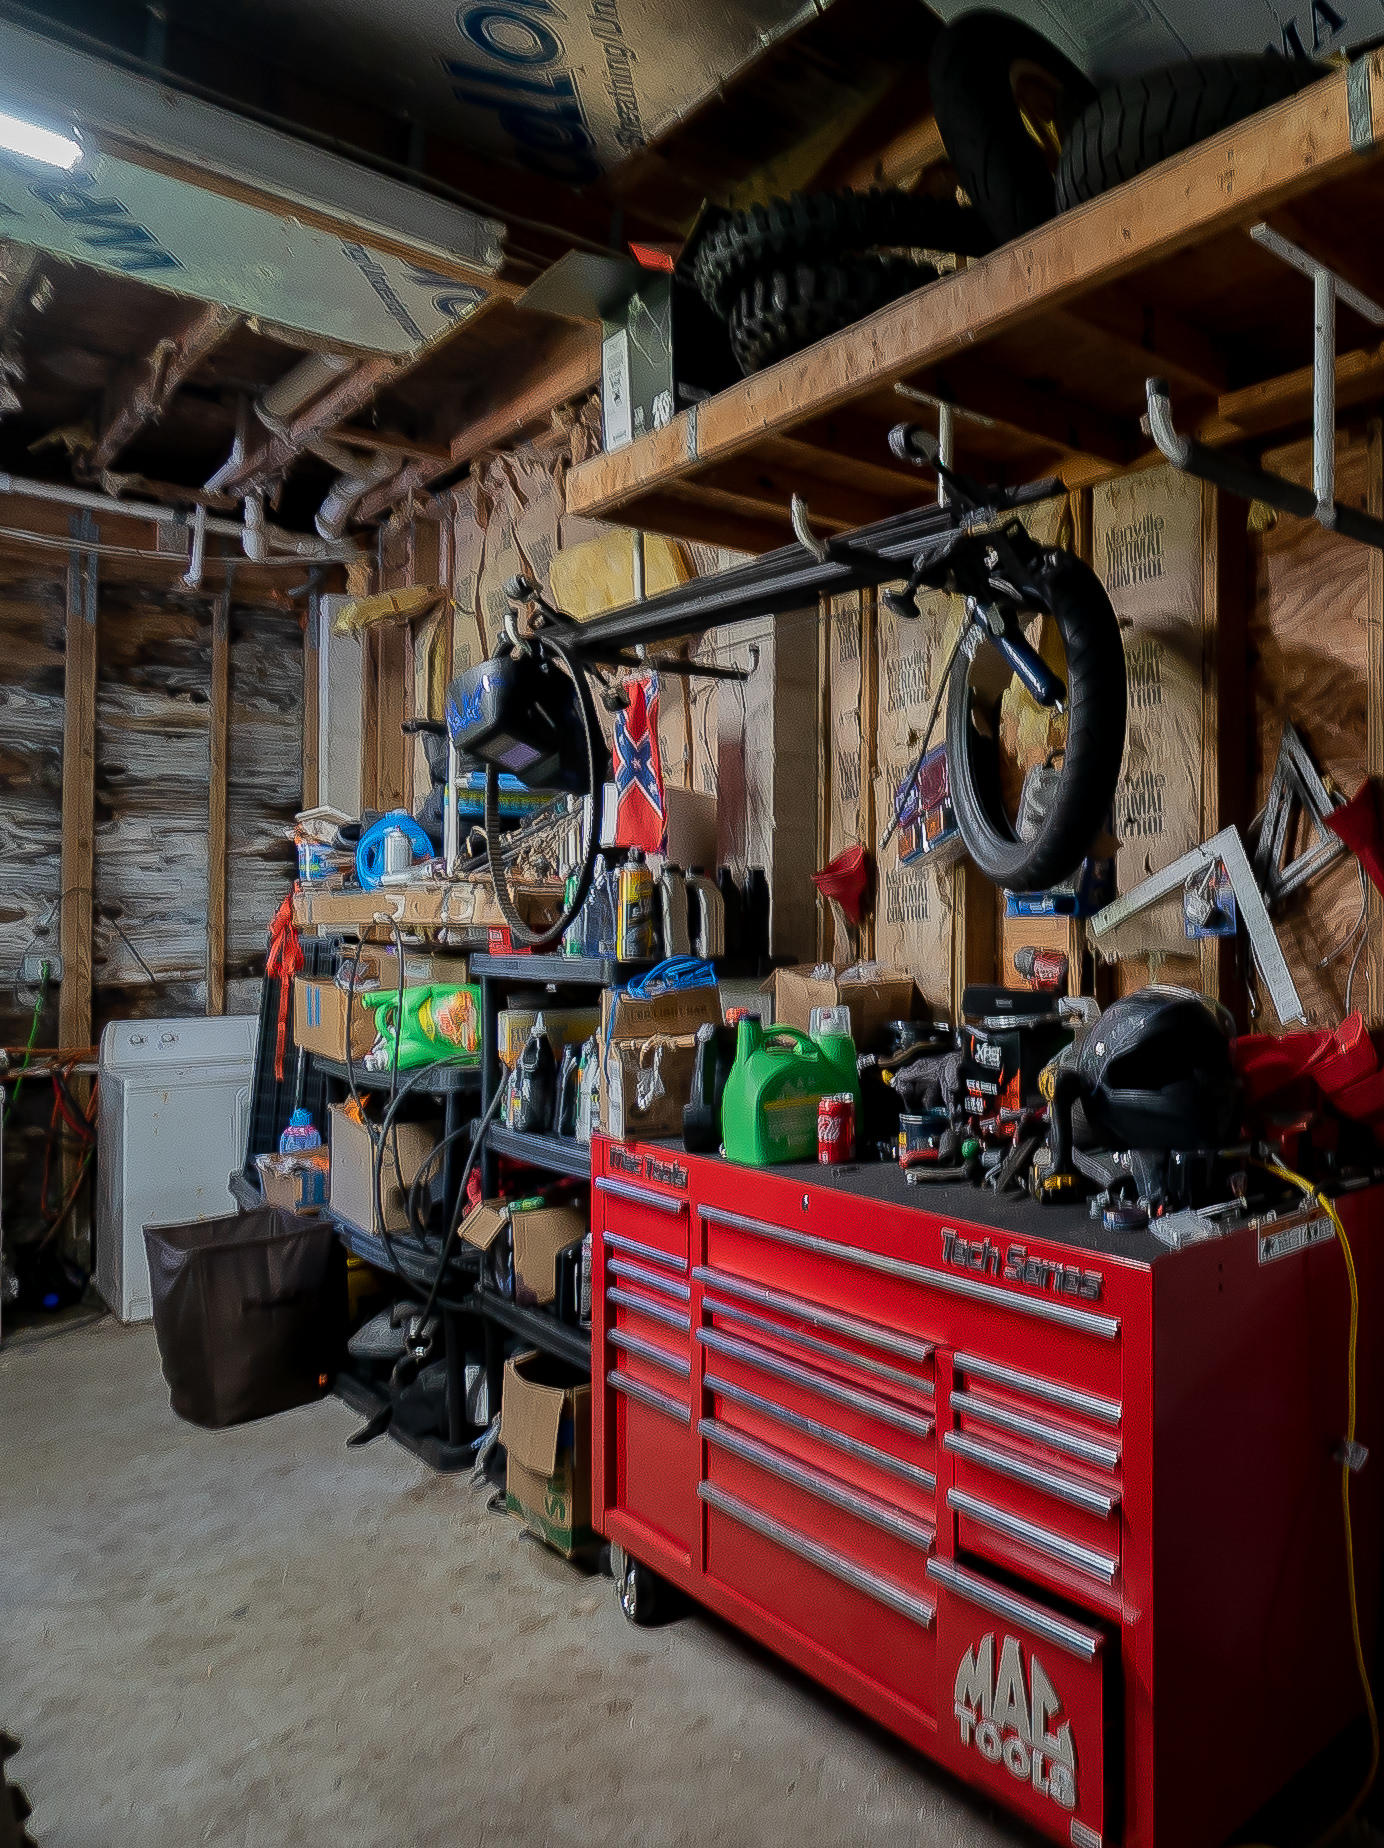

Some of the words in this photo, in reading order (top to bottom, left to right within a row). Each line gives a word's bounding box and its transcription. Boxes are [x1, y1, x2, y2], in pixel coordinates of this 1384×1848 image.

[1105, 513, 1165, 549] Manville
[941, 1227, 1000, 1278] Tech
[1004, 1243, 1104, 1301] Series
[954, 1631, 1079, 1769] MAC
[954, 1700, 1076, 1811] TOOLS
